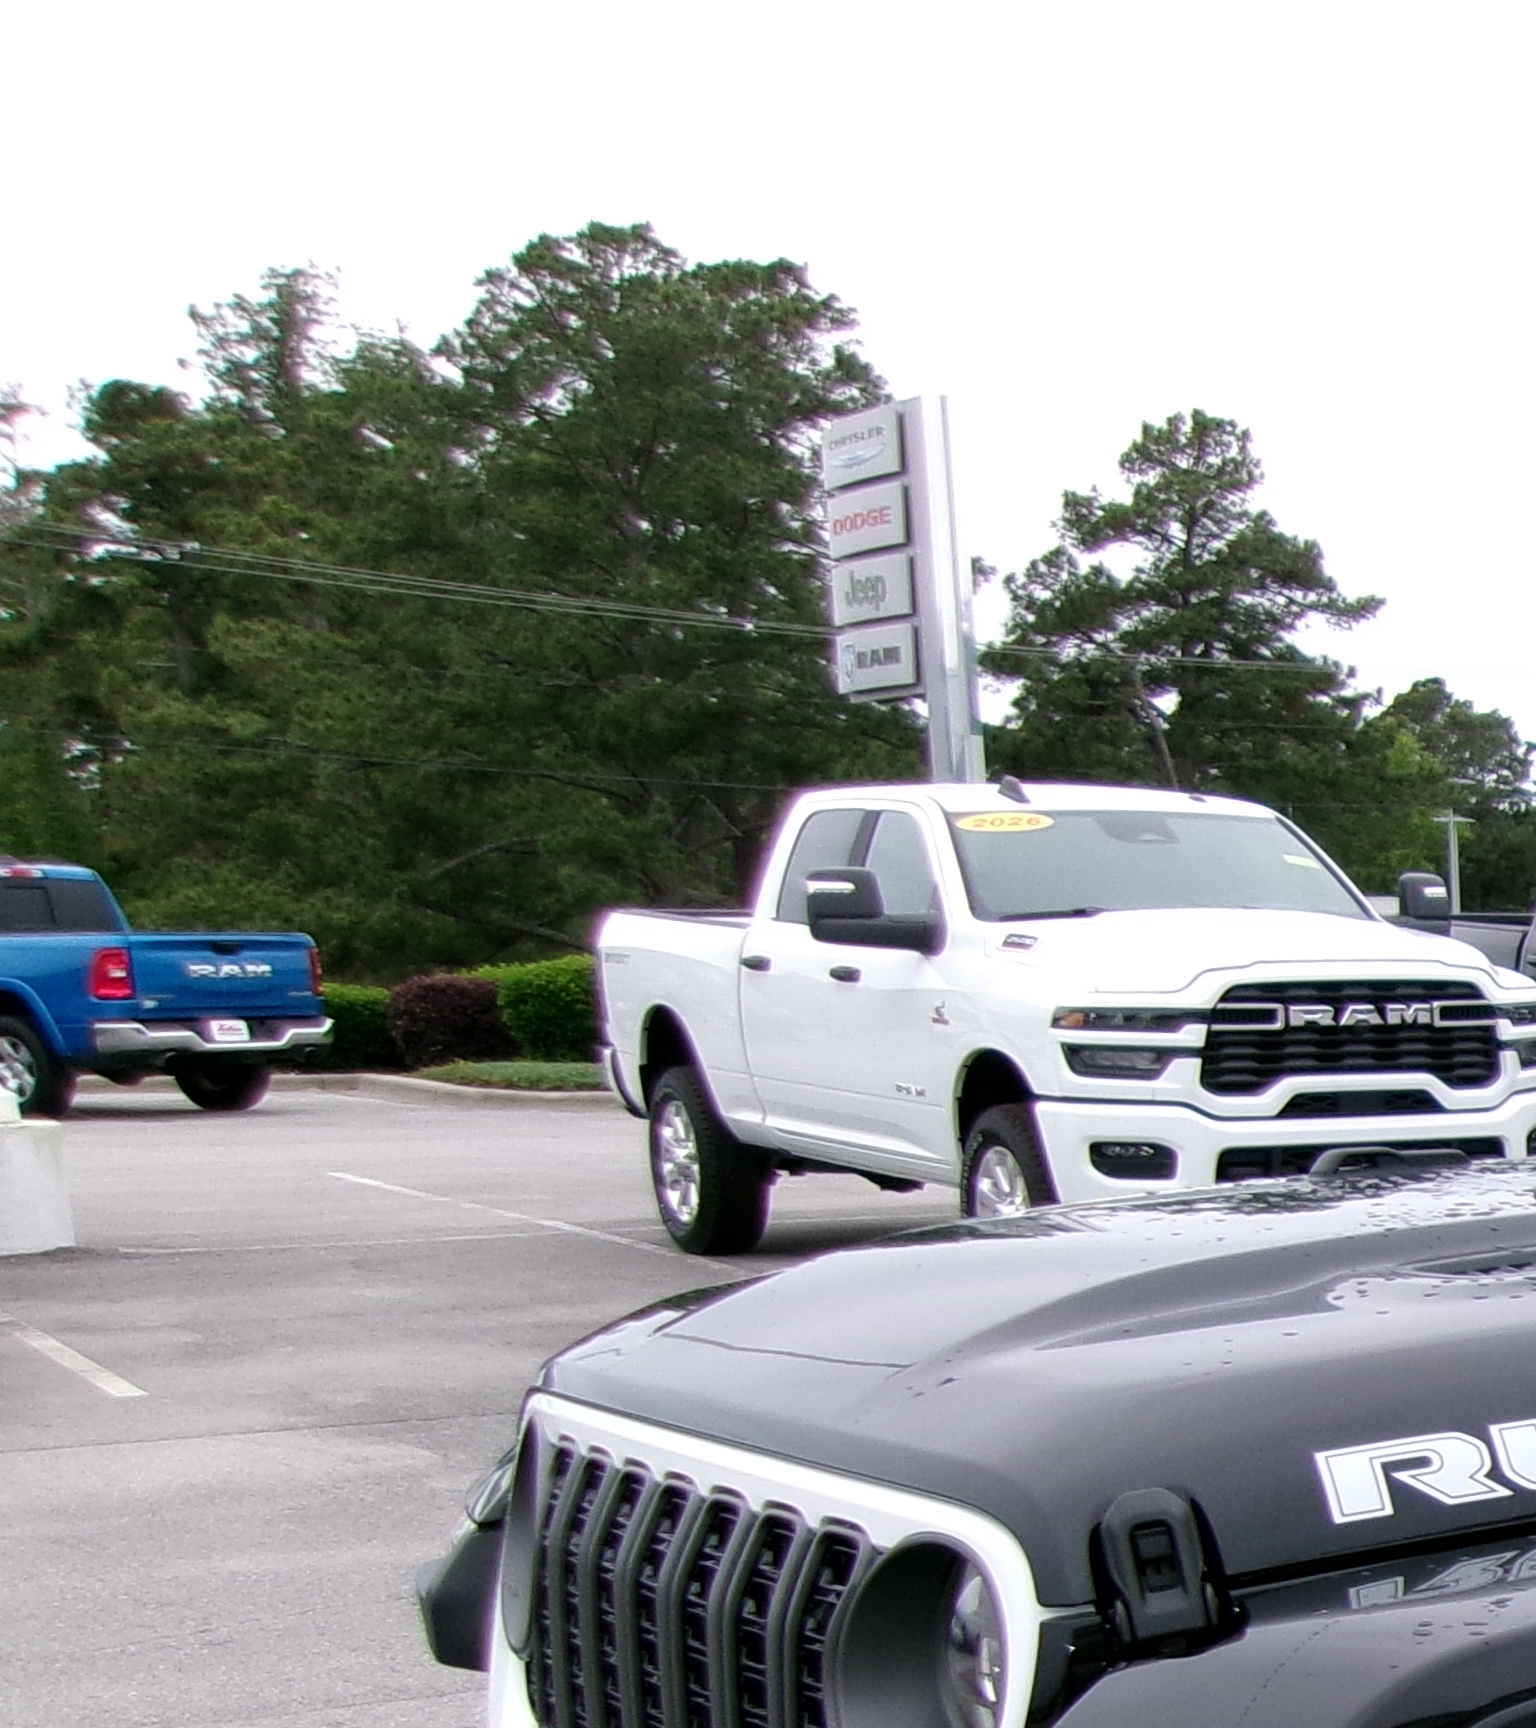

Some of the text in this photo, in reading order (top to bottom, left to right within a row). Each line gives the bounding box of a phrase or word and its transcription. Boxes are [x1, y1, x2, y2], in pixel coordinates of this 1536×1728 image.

[829, 425, 885, 451] CHRYSLER
[833, 506, 892, 537] DODGE
[845, 569, 888, 612] Jeep
[972, 816, 1041, 828] 2026
[188, 964, 273, 979] RAM
[1289, 1004, 1433, 1027] RAM
